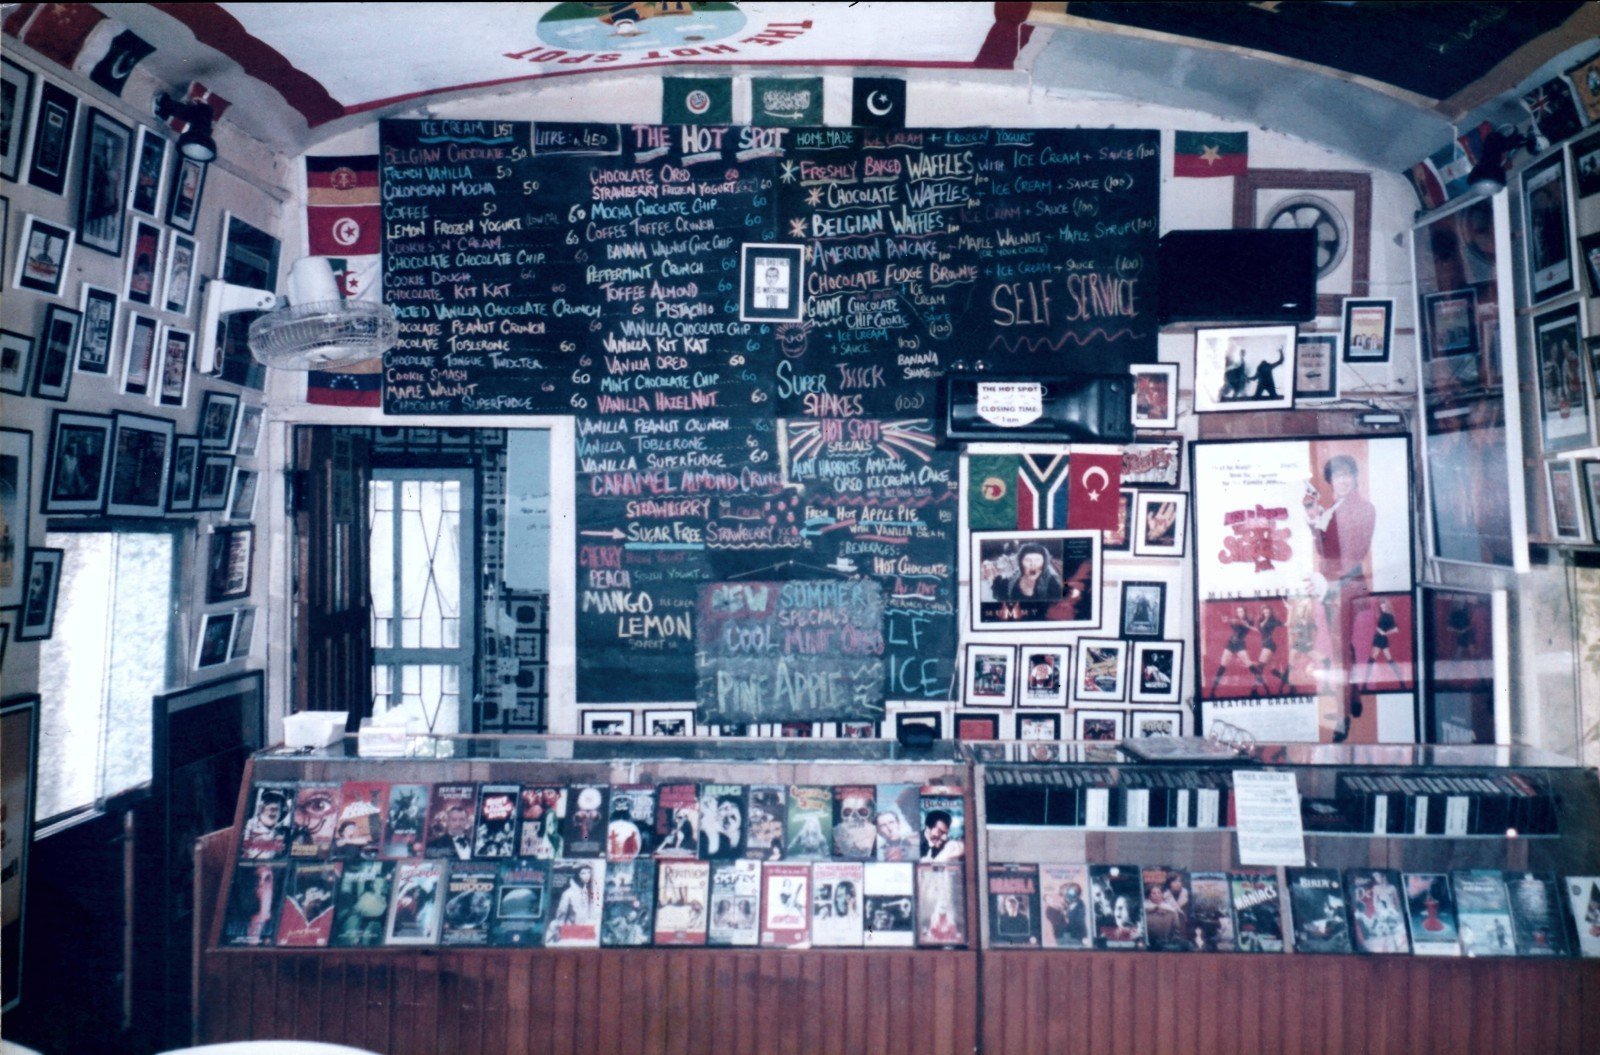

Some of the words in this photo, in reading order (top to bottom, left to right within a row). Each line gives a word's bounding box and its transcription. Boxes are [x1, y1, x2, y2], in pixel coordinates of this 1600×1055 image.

[739, 19, 814, 47] THE
[503, 47, 622, 64] SPOT
[640, 44, 739, 60] HOT
[493, 123, 514, 138] LIST
[632, 125, 673, 149] THE
[681, 127, 730, 154] HOT
[738, 127, 790, 150] SPOT
[995, 130, 1035, 143] YOGURT
[447, 143, 505, 162] CHOCOLATE
[427, 166, 473, 181] VANILLA
[800, 160, 858, 181] FRESHLY
[864, 155, 901, 177] BAKED
[905, 150, 974, 178] WAFFLES
[1014, 150, 1034, 168] ICE
[1041, 146, 1081, 165] CREAM
[589, 167, 654, 186] CHOCOLATE
[451, 183, 496, 196] MOCHA
[591, 184, 659, 200] STRAWBERRY
[698, 181, 737, 195] YOGURT
[827, 182, 901, 209] CHOCOLATE
[905, 182, 971, 209] WAFFLES
[992, 182, 1010, 196] ICE
[1015, 176, 1052, 193] CREAM
[1067, 178, 1100, 191] SAUCE
[384, 203, 430, 219] COFFEE
[591, 202, 633, 220] MOCHA
[635, 198, 690, 217] CHOCOLATE
[692, 198, 718, 214] CHIP
[812, 209, 885, 238] BELGIAN
[889, 203, 944, 235] WAFFLES
[1036, 200, 1070, 216] SAUCE
[387, 221, 426, 239] LEMON
[434, 220, 474, 236] FROZEN
[479, 217, 523, 234] YOGURT
[586, 220, 628, 243] COFFEE
[630, 217, 674, 237] TOFFEE
[675, 216, 716, 231] CRUNCH
[457, 238, 502, 251] CREAM
[607, 242, 648, 260] BANANA
[712, 234, 733, 250] CHIP
[885, 238, 938, 261] PANCAKE
[959, 234, 994, 251] MAPLE
[996, 228, 1042, 247] WALNUT
[1060, 224, 1091, 244] MAPLE
[388, 254, 451, 272] CHOCOLATE
[455, 250, 512, 267] CHOCOLATE
[384, 272, 426, 288] COOKIE
[432, 270, 472, 286] DOUGH
[586, 263, 653, 285] PEPPERMINT
[661, 260, 704, 278] CRUNCH
[808, 270, 880, 296] CHOCOLATE
[885, 262, 924, 287] FUDGE
[997, 265, 1014, 277] ICE
[1066, 259, 1095, 270] SAUCE
[386, 289, 444, 302] CHOCOLATE
[454, 283, 477, 299] KIT
[483, 283, 512, 297] KAT
[599, 282, 646, 302] TOFFEE
[650, 279, 699, 299] ALMOND
[992, 279, 1053, 326] SELF
[1066, 272, 1140, 321] SERVICE
[434, 304, 482, 320] VANILLA
[484, 303, 548, 317] CHOCOLATE
[552, 299, 601, 317] CRUNCH
[656, 302, 715, 320] PISTACHIO
[807, 295, 843, 319] GIANT
[848, 295, 900, 313] CHOCOLATE
[452, 319, 495, 335] PEANUT
[500, 318, 546, 335] CRUNCH
[620, 319, 671, 338] VANILLA
[674, 321, 725, 336] CHOCOLATE
[447, 334, 511, 354] TOBLERONE
[603, 331, 651, 353] VANILLA
[656, 337, 678, 353] KIT
[683, 337, 709, 353] KAT
[383, 352, 435, 368] CHOCOLATE
[443, 352, 486, 368] TONGUE
[604, 354, 650, 375] VANILLA
[656, 355, 689, 370] OREO
[898, 350, 939, 366] BANANA
[386, 368, 426, 383] COOKIE
[430, 368, 468, 382] SMASH
[601, 375, 632, 393] MINT
[634, 372, 691, 389] CHOCOLATE
[693, 371, 721, 388] CHIP
[777, 360, 828, 400] SUPER
[835, 362, 886, 391] THICK
[386, 386, 426, 402] MAPLE
[427, 382, 479, 397] WALNUT
[597, 394, 650, 413] VANILLA
[803, 393, 864, 418] SHAKES
[577, 417, 629, 437] VANILLA
[634, 417, 680, 434] PEANUT
[684, 417, 730, 432] CRUNCH
[822, 418, 843, 442] HOT
[848, 418, 881, 442] SPOT
[576, 437, 625, 458] VANILLA
[631, 433, 708, 453] TOBLERONE
[828, 439, 873, 452] SPECIALS
[581, 456, 638, 473] VANILLA
[918, 465, 950, 485] CAKE
[590, 470, 678, 497] CARAMEL
[681, 468, 739, 491] ALMOND
[626, 498, 710, 520] STRAWBERRY
[836, 505, 857, 520] HOT
[861, 505, 895, 521] APPLE
[898, 504, 919, 521] PIE
[627, 521, 671, 542] SUGAR
[673, 520, 704, 542] FREE
[706, 521, 775, 542] STRAWBERRY
[875, 525, 914, 537] VANILLA
[874, 558, 897, 574] HOT
[898, 556, 950, 578] CHOCOLATE
[590, 569, 632, 588] PEACH
[582, 590, 654, 614] MANGO
[711, 585, 770, 613] NEW
[780, 583, 865, 610] SUMMER
[1208, 590, 1242, 600] MIKE
[618, 612, 692, 640] LEMON
[778, 610, 850, 627] SPECIALS
[727, 625, 781, 651] COOL
[784, 628, 834, 655] MINT
[1213, 700, 1261, 709] HEATHER
[1268, 697, 1313, 706] GRAHAM
[450, 883, 493, 892] BROOD
[1235, 886, 1277, 910] MANIACS
